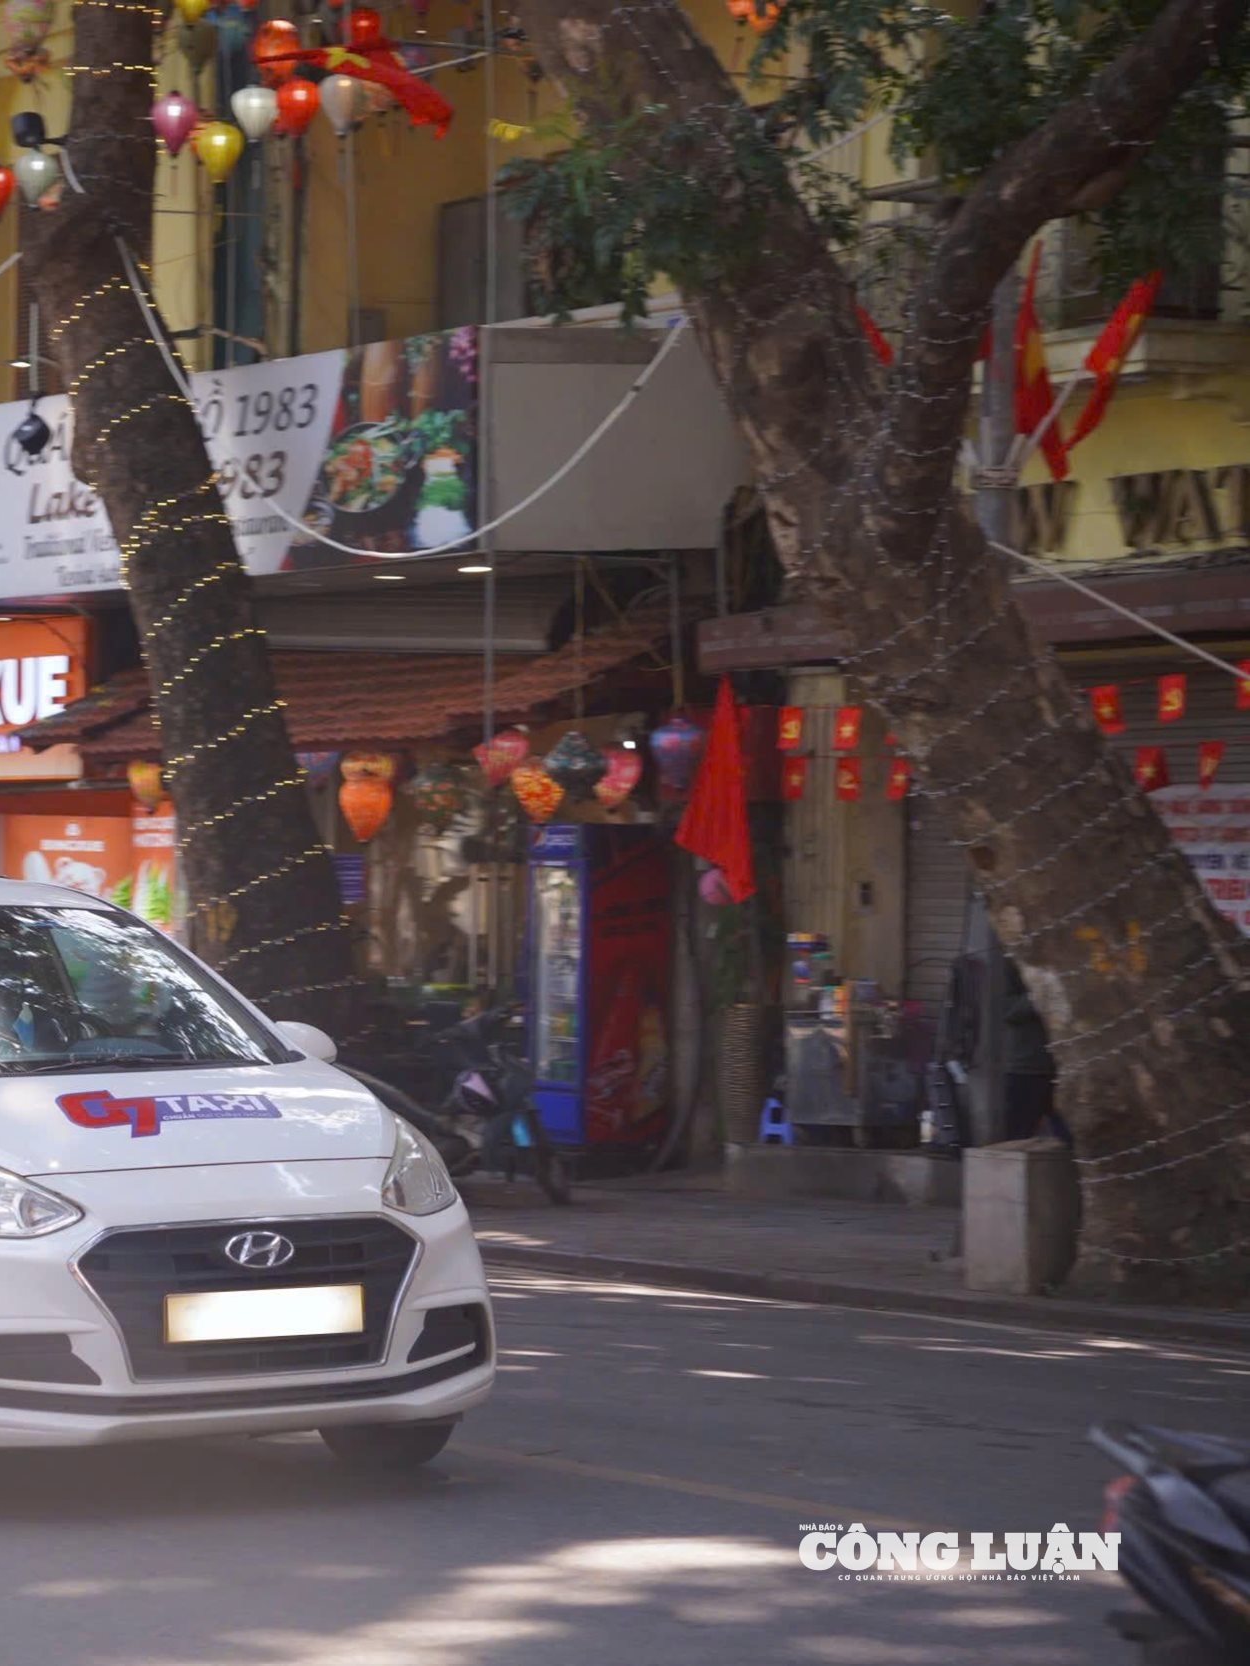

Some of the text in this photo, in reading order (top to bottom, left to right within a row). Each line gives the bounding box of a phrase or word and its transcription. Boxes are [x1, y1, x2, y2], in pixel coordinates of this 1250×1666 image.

[233, 382, 320, 438] 1983
[216, 450, 288, 501] 983
[55, 1089, 268, 1138] G7 TAXI
